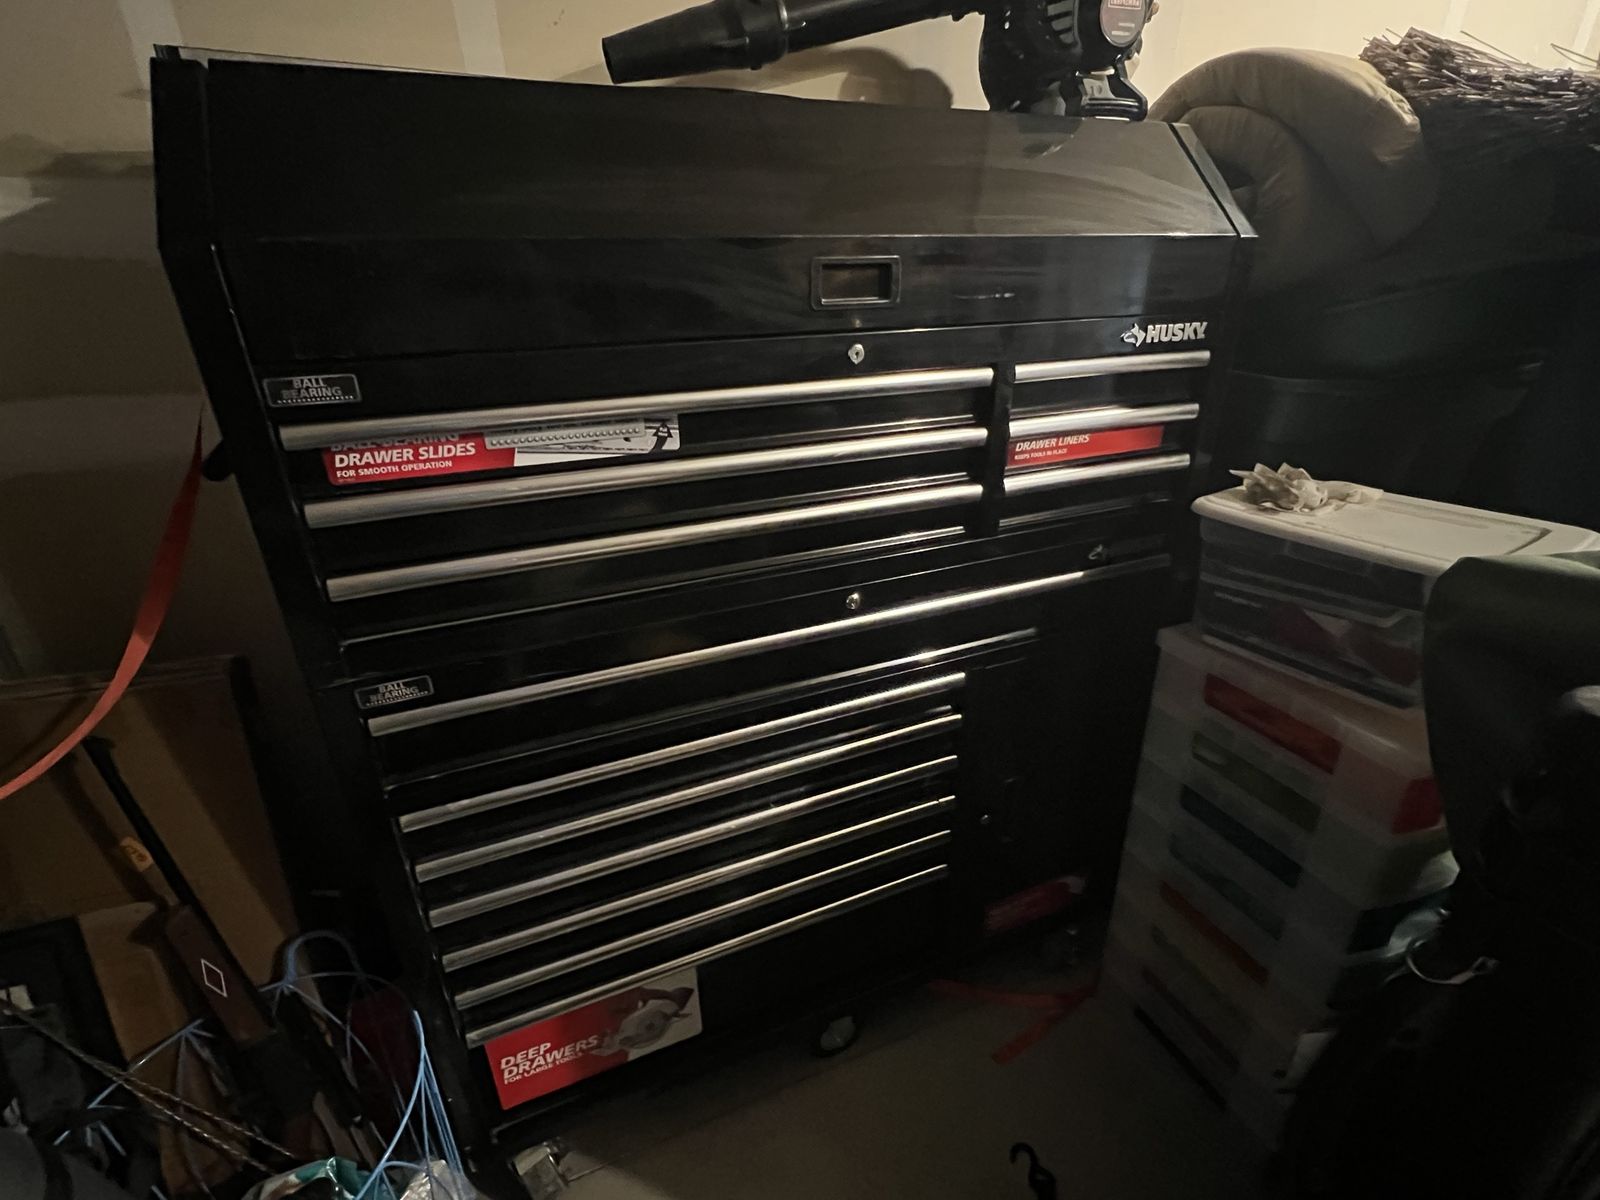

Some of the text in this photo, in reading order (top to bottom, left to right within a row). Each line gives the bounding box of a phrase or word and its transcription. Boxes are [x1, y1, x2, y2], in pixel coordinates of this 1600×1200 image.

[1146, 321, 1208, 343] HUSKY
[280, 386, 342, 399] BEARING
[293, 378, 327, 389] BALL
[1015, 433, 1090, 452] DRAWER LINERS
[334, 442, 476, 468] DRAWER SLIDES
[336, 460, 453, 478] FOR SMOOTH OPERATION
[500, 1042, 552, 1070] DEEP
[503, 1035, 598, 1079] DRAWERS
[504, 1074, 522, 1085] FOR
[523, 1064, 554, 1078] LARGE
